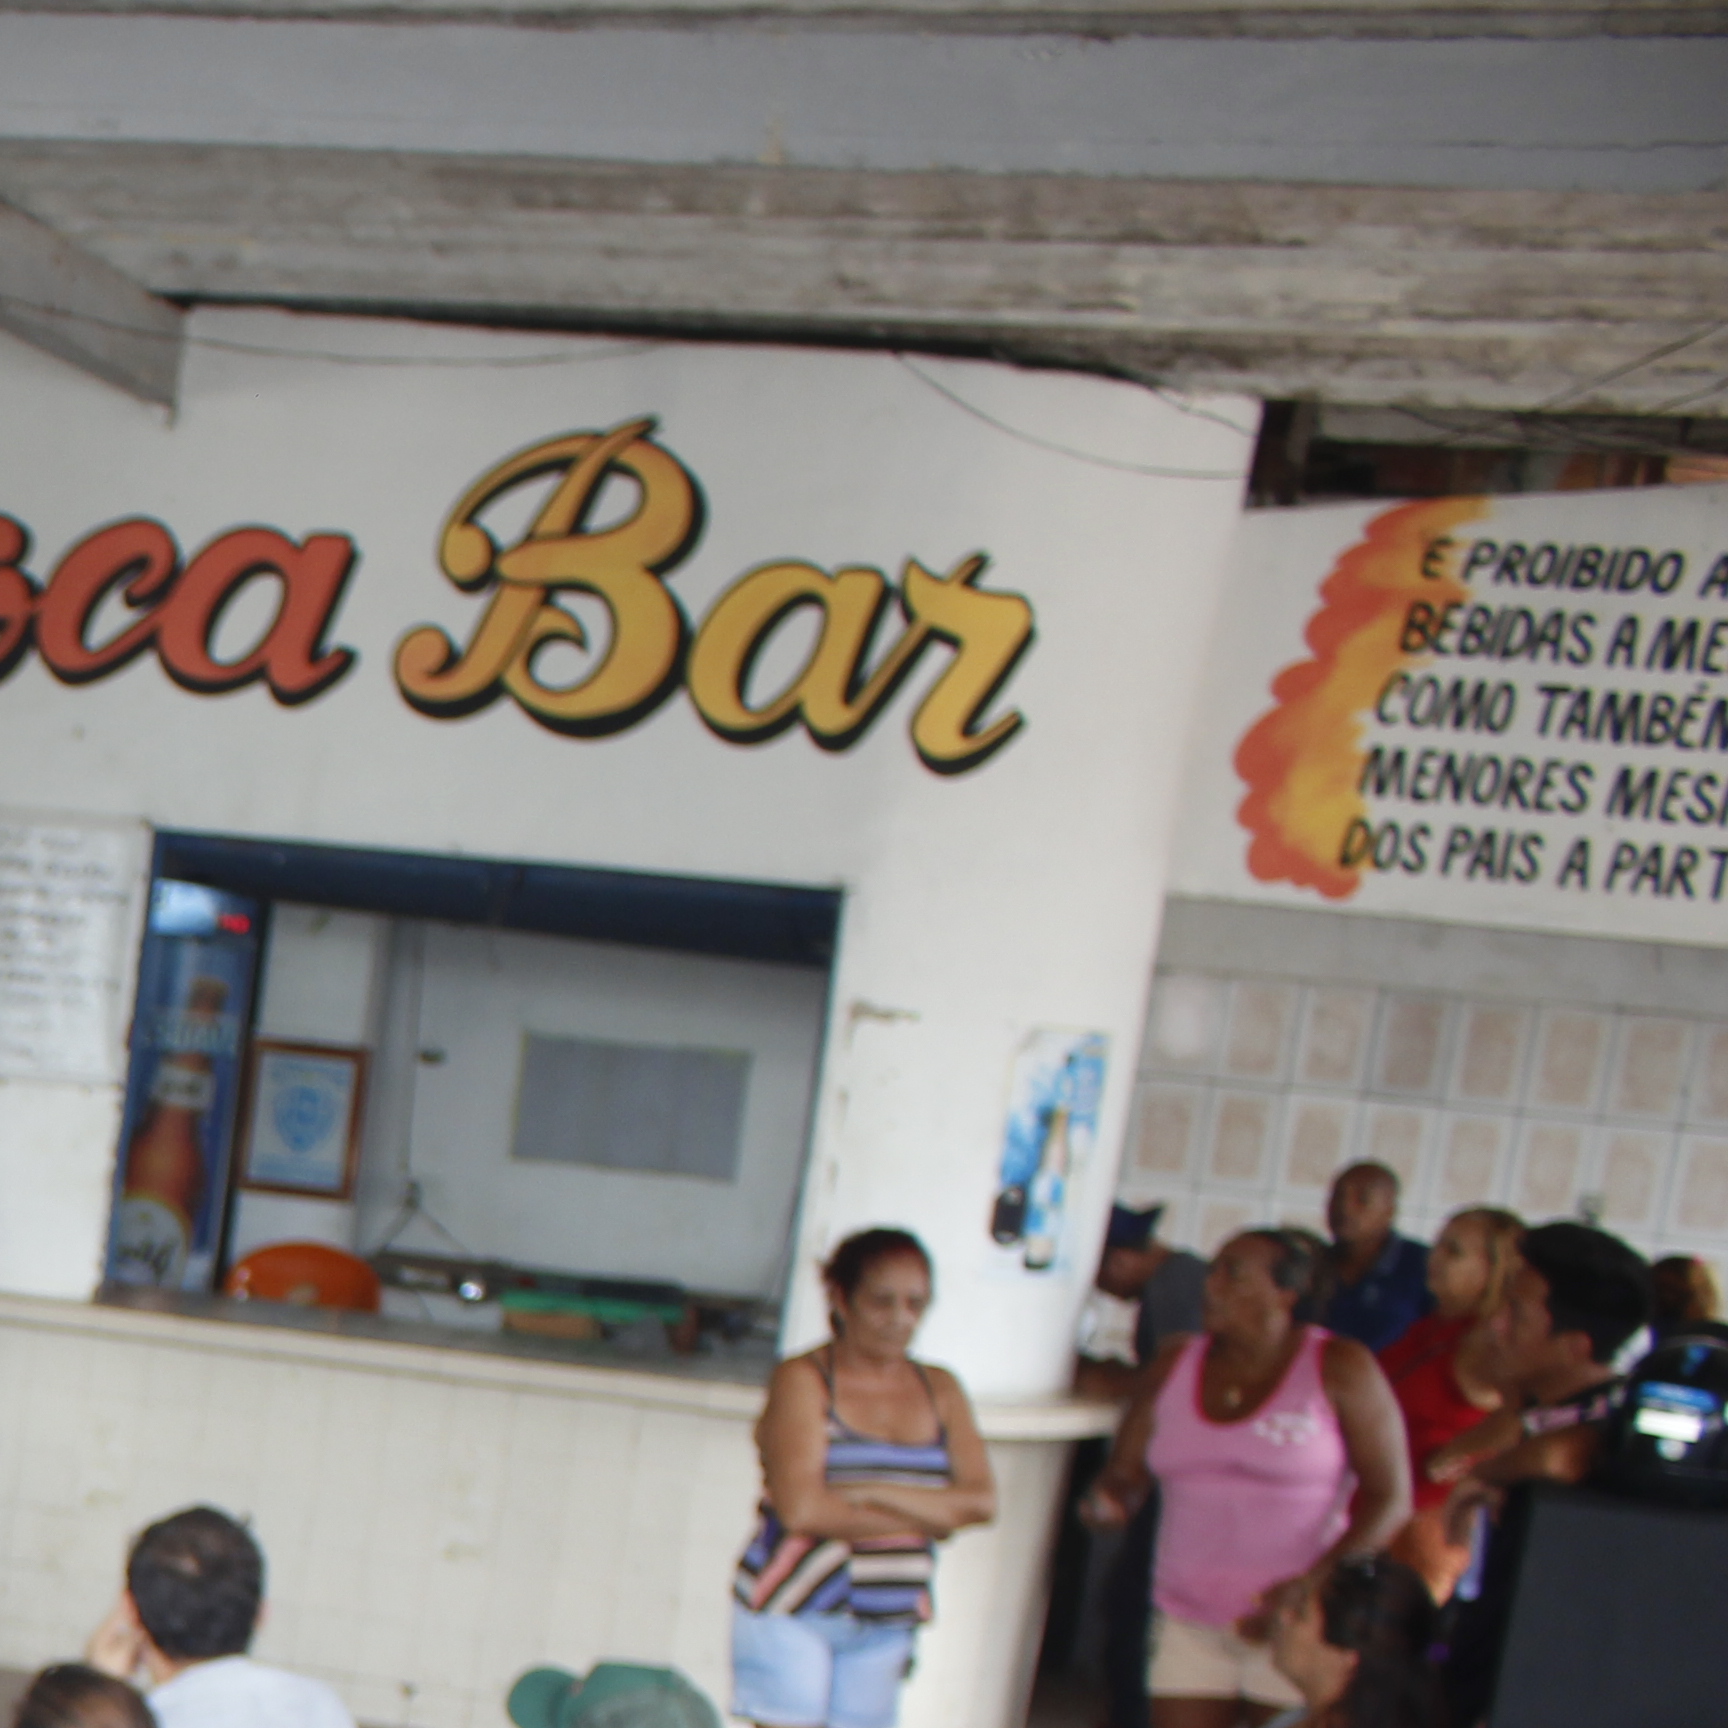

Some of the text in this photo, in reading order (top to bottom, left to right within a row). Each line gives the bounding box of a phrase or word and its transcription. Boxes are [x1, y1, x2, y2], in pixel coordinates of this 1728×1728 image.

[394, 414, 1036, 780] Bar
[1462, 540, 1684, 594] PROIBIDO
[1401, 600, 1596, 666] BEBIDAS
[1606, 614, 1641, 671] A
[1376, 671, 1517, 734] COMO
[1359, 745, 1728, 828] MENORES MES
[1340, 817, 1431, 873] DOS
[1441, 827, 1544, 884] PAIS
[1557, 837, 1592, 891] A
